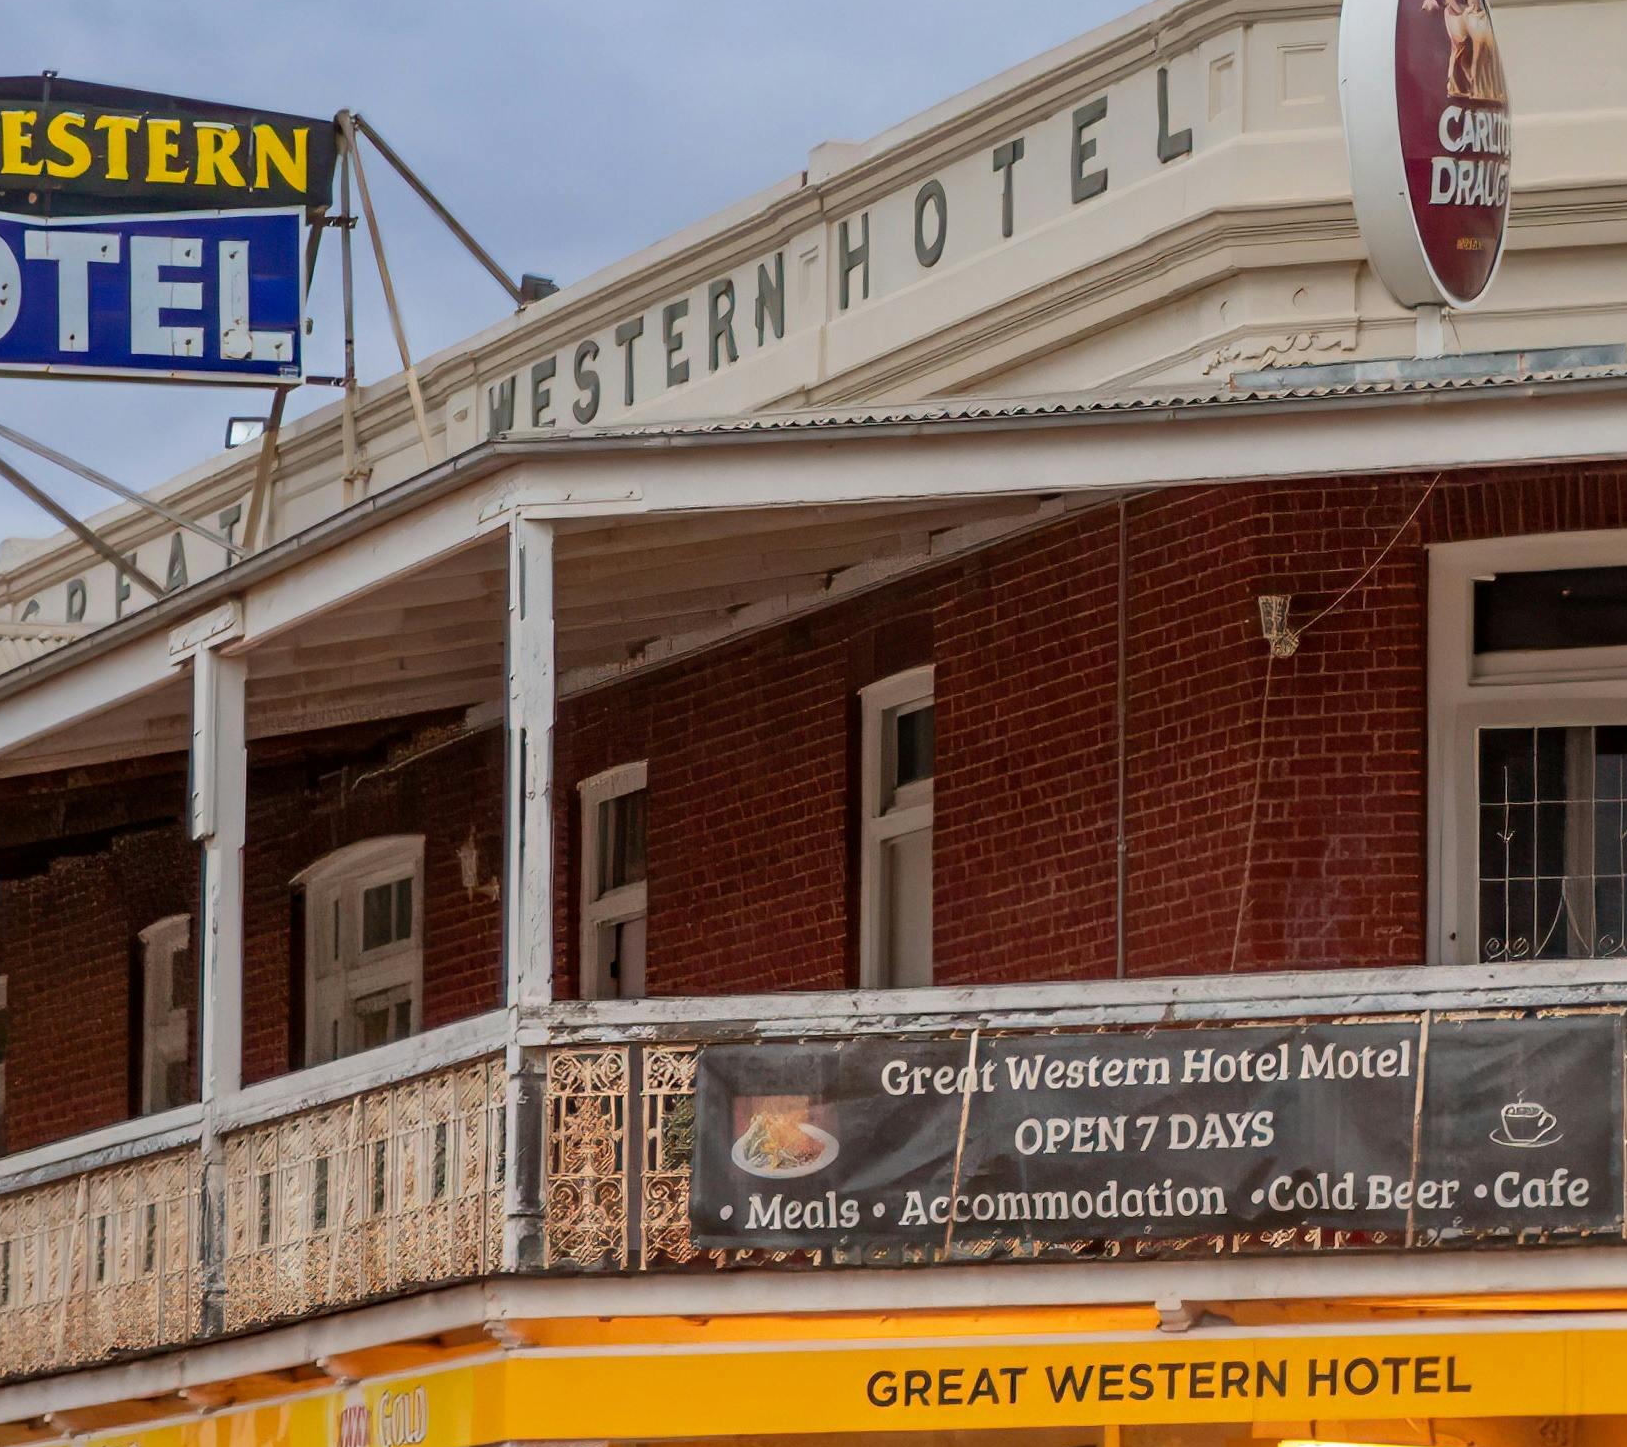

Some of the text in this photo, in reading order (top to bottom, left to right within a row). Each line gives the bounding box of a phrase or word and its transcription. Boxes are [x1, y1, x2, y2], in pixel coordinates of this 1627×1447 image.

[488, 251, 785, 440] WESTERN
[838, 67, 1193, 310] HOTEL
[881, 1037, 1412, 1097] Great Western Hotel Motel
[1014, 1110, 1275, 1157] OPEN 7 DAYS
[747, 1170, 1590, 1231] Meals Accommodation Cold Beer Cafe
[867, 1355, 1473, 1409] GREAT WESTERN HOTEL
